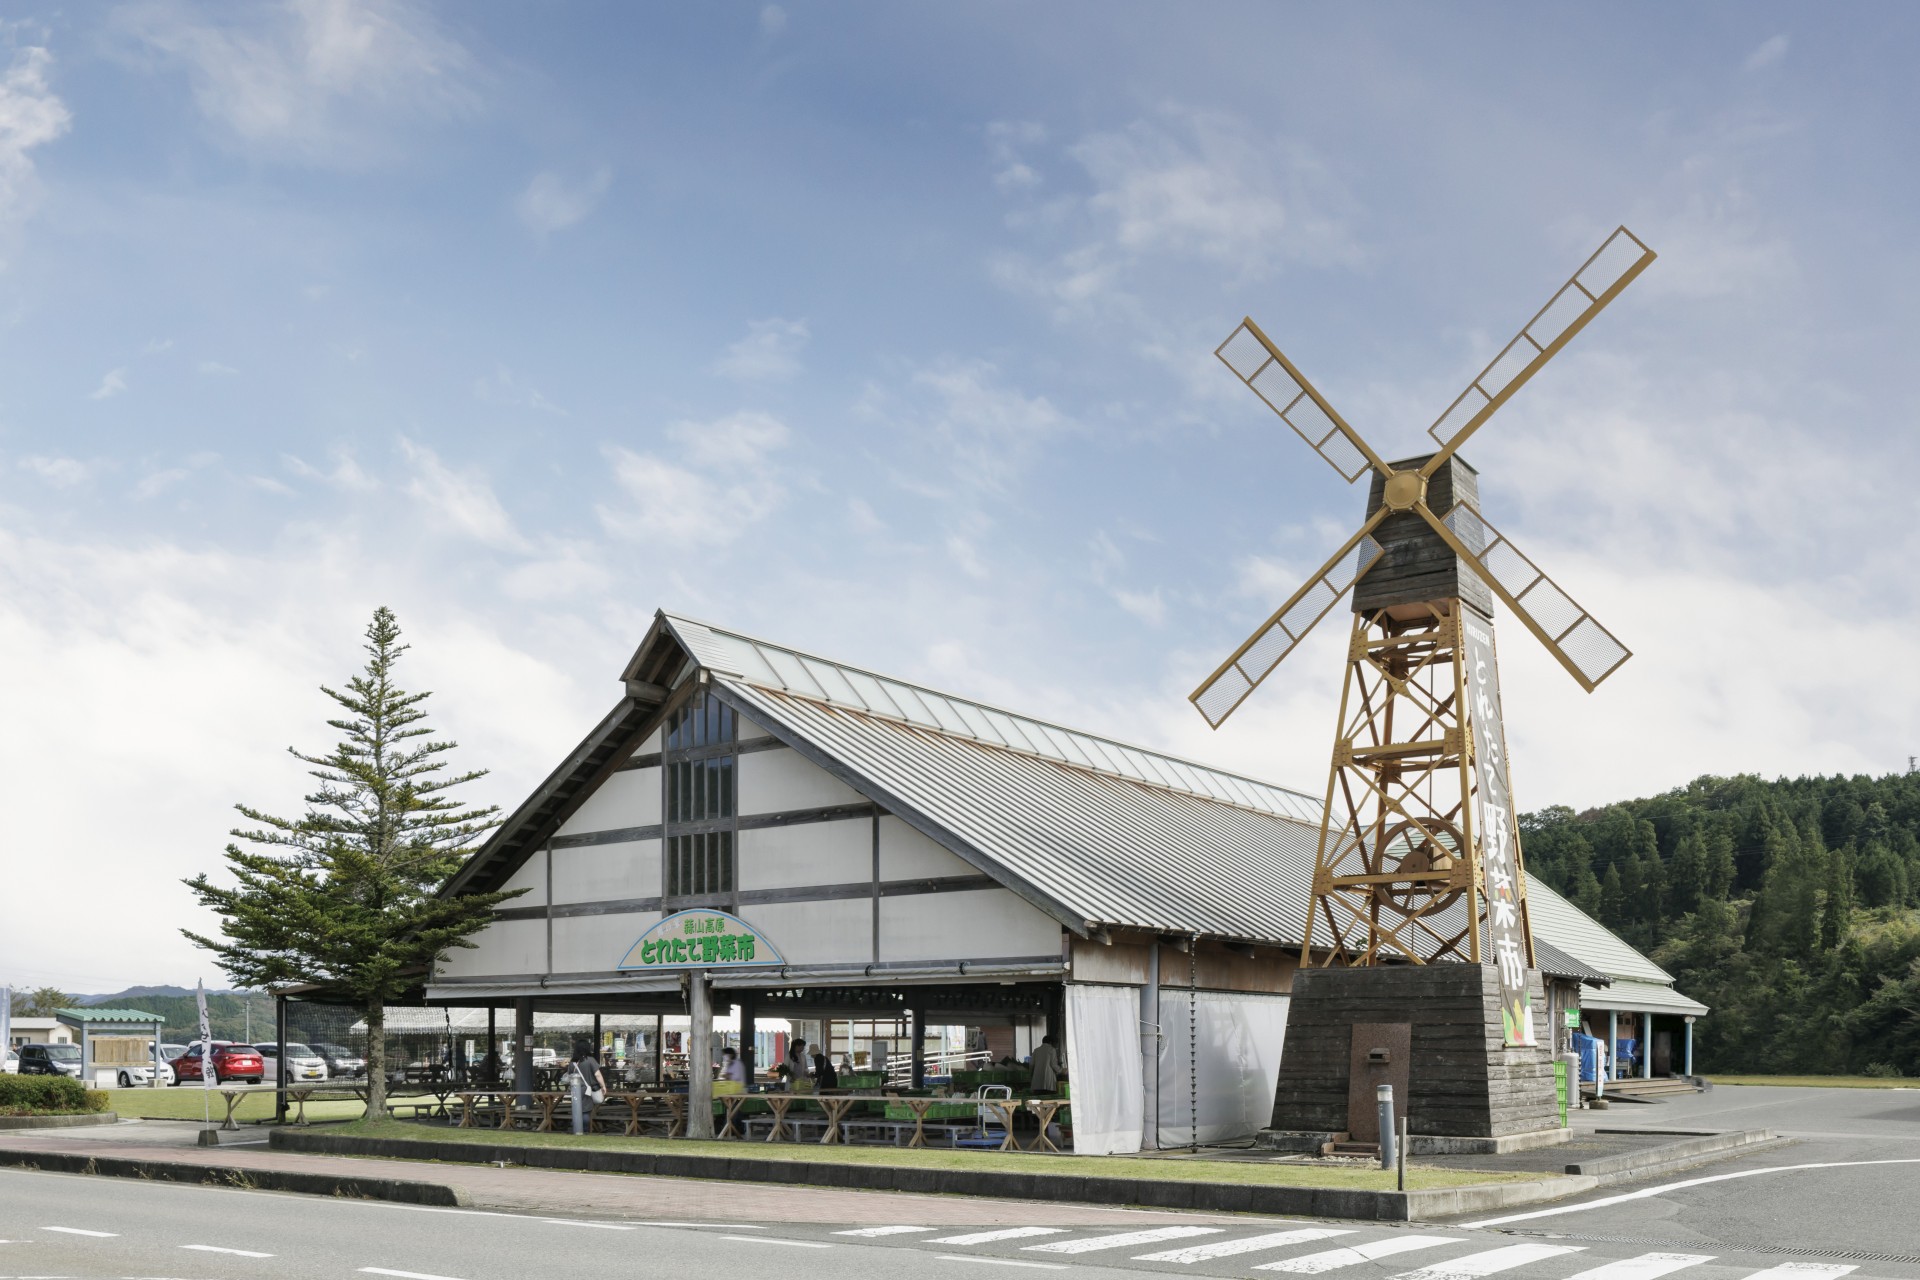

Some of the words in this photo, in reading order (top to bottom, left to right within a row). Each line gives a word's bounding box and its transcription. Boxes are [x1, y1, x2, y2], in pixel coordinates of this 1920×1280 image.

[1474, 646, 1523, 991] とれたて野菜市
[684, 917, 725, 934] 蒜山高原
[641, 934, 755, 964] とれたて野菜市
